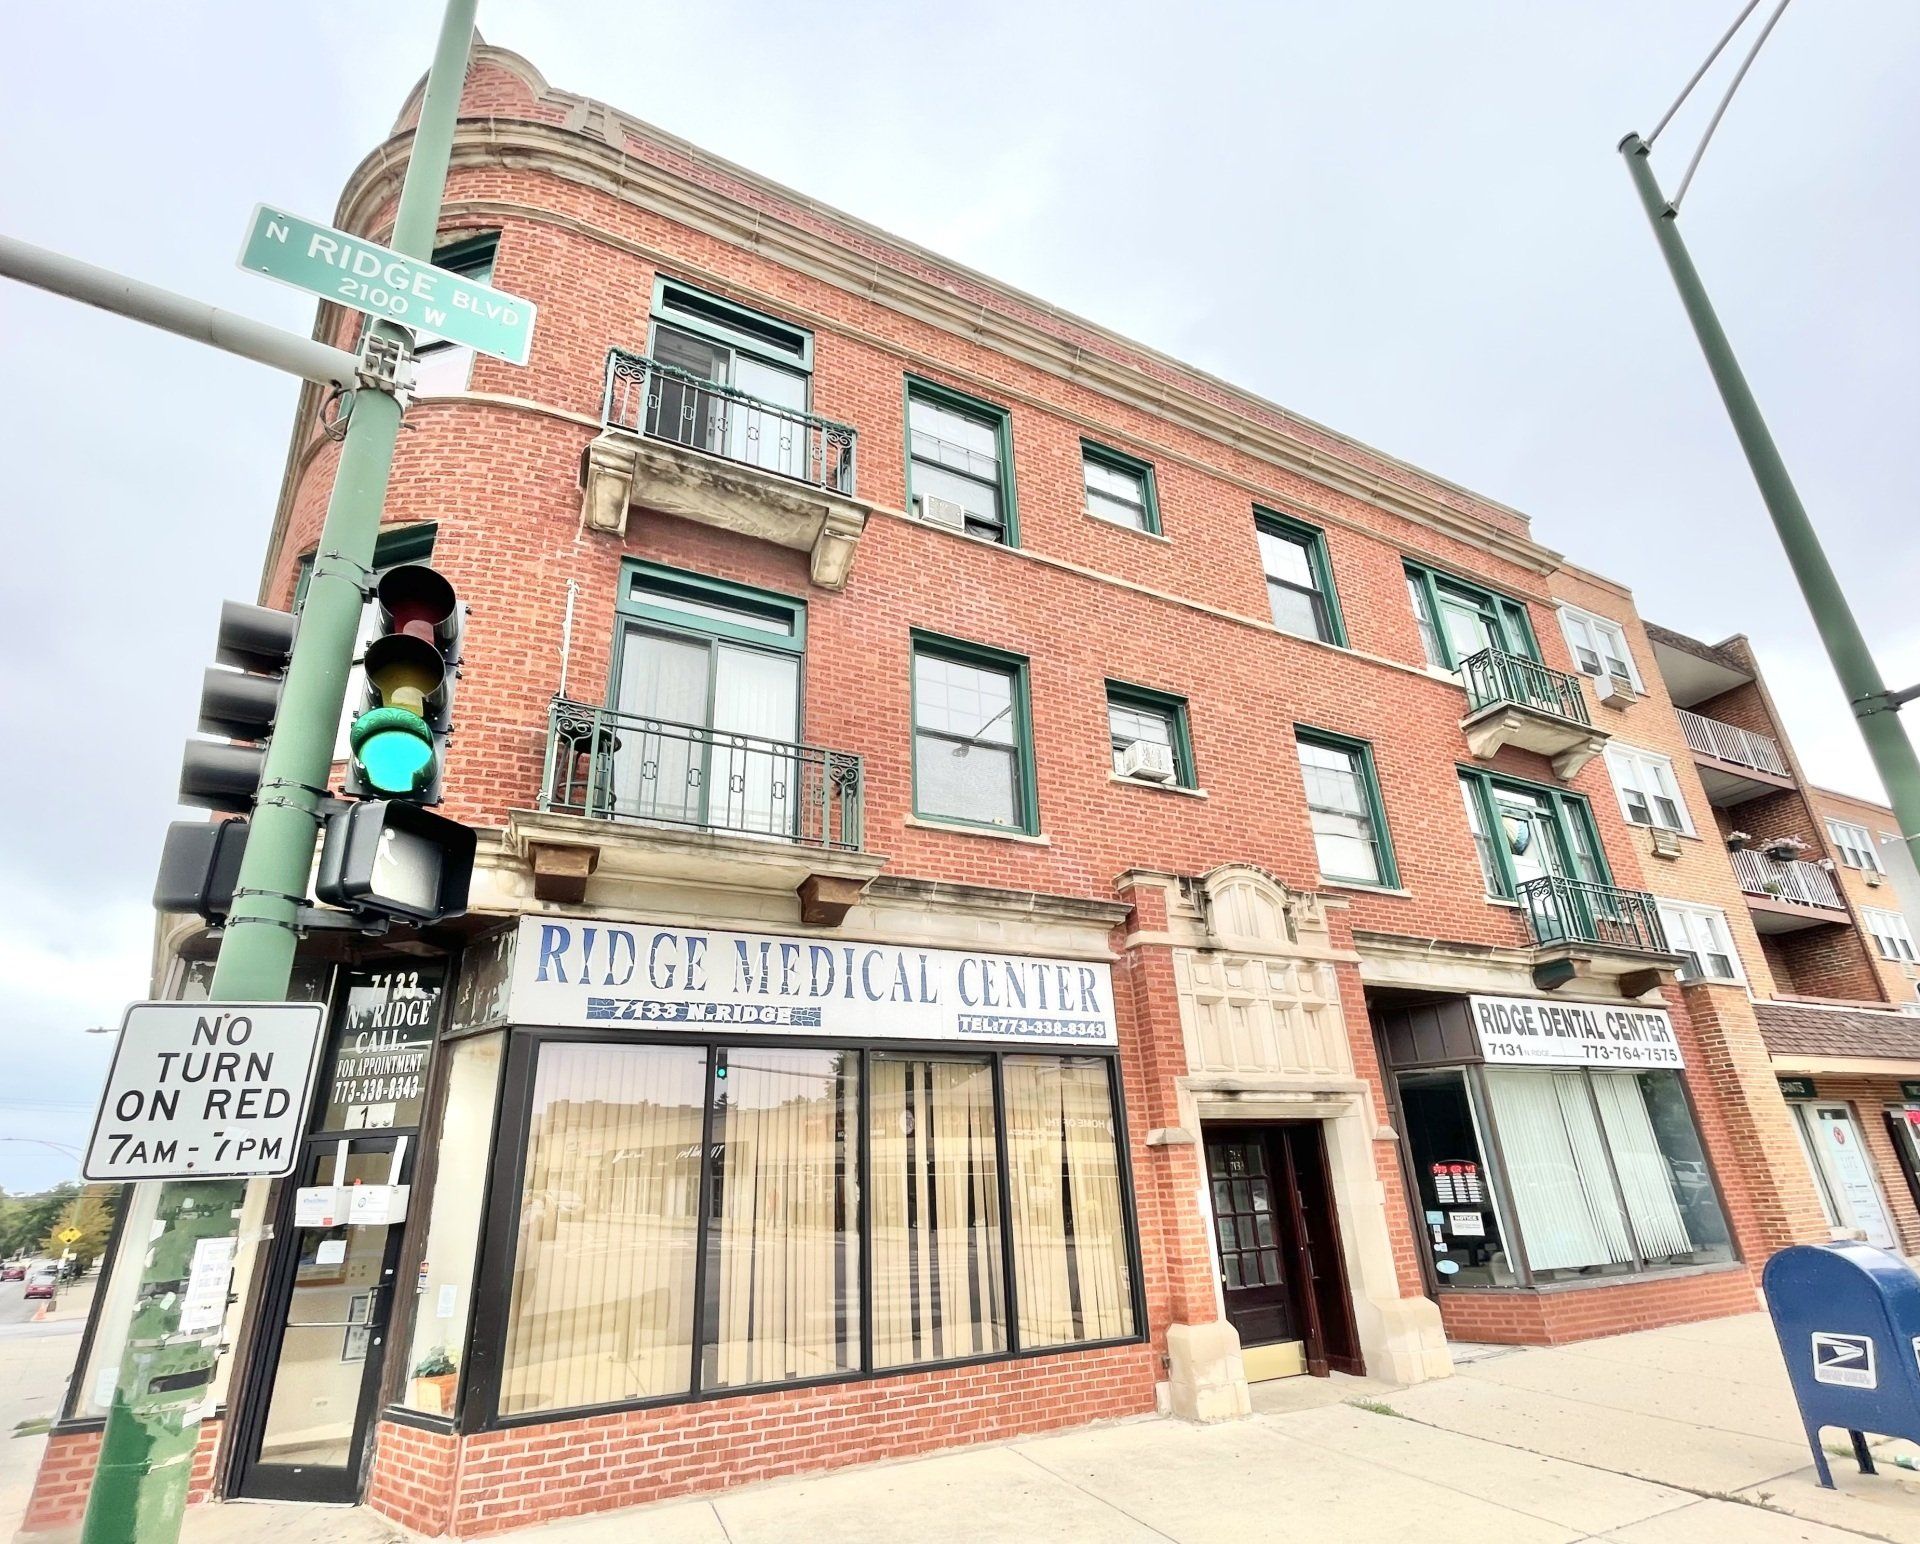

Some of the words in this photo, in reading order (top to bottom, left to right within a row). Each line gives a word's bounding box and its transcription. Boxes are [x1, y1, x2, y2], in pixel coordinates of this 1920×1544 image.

[265, 220, 290, 244] N
[306, 232, 438, 303] RIDGE
[452, 291, 519, 327] BLVD
[337, 276, 409, 315] 2100
[423, 305, 448, 328] W
[534, 924, 708, 992] RIDGE
[733, 939, 939, 1004] MEDICAL
[957, 957, 1102, 1014] CENTER
[370, 971, 419, 1001] 7133
[345, 1004, 364, 1030] N.
[371, 999, 432, 1028] RIDGE
[612, 998, 677, 1021] 7133
[1477, 1002, 1539, 1036] RIDGE
[1537, 1006, 1606, 1040] DENTAL
[1605, 1011, 1672, 1043] CENTER
[191, 1016, 253, 1046] NO
[355, 1029, 408, 1054] CALL:
[1488, 1042, 1524, 1057] 7131
[1581, 1044, 1679, 1062] 773-764-7575
[157, 1052, 274, 1083] TURN
[336, 1058, 356, 1079] FOR
[356, 1053, 424, 1077] APPOINTMENT
[115, 1089, 181, 1121] ON
[202, 1088, 291, 1120] RED
[333, 1075, 419, 1104] 773-338-8343
[107, 1133, 178, 1165] 7AM
[213, 1131, 283, 1162] 7PM
